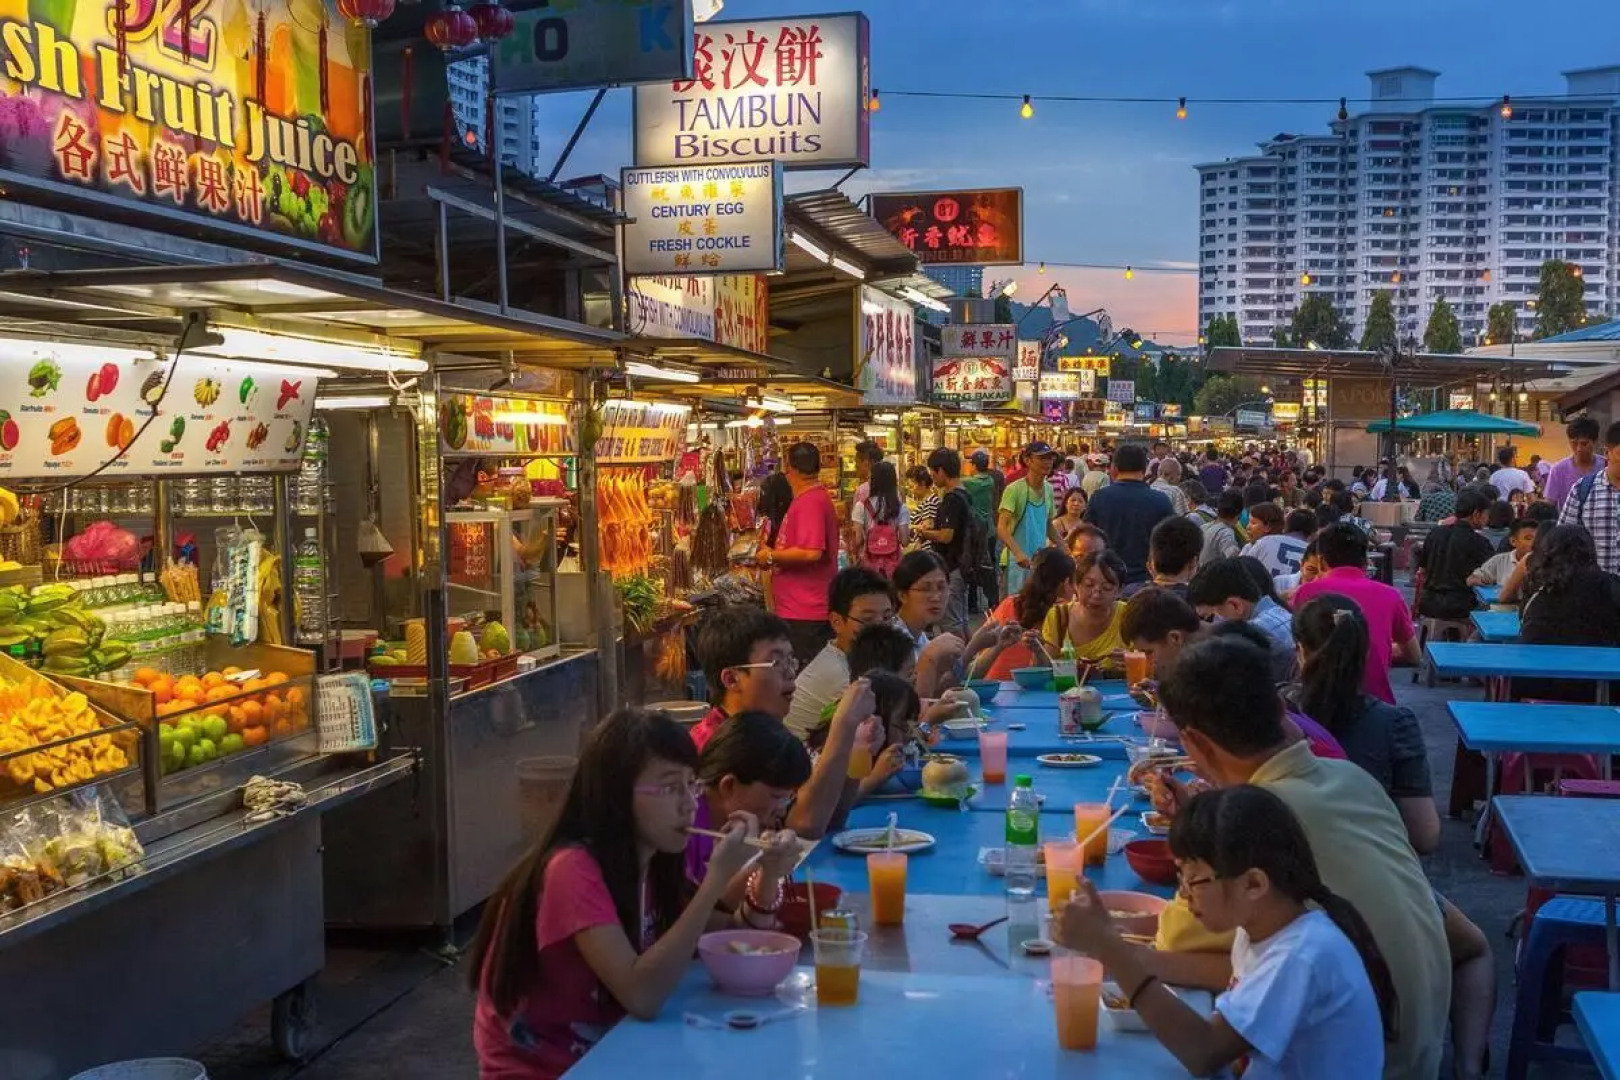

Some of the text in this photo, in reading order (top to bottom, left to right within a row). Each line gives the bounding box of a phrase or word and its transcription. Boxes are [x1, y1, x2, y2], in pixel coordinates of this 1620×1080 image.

[97, 45, 236, 148] Fruit
[246, 99, 359, 185] Juice
[672, 92, 822, 132] TAMBUN
[674, 131, 822, 159] Biscuits
[627, 165, 769, 185] CUTTLEFISH WITH CONVOLVULUS
[651, 201, 745, 218] CENTURY EGG
[650, 235, 750, 252] FRESH COCKLE
